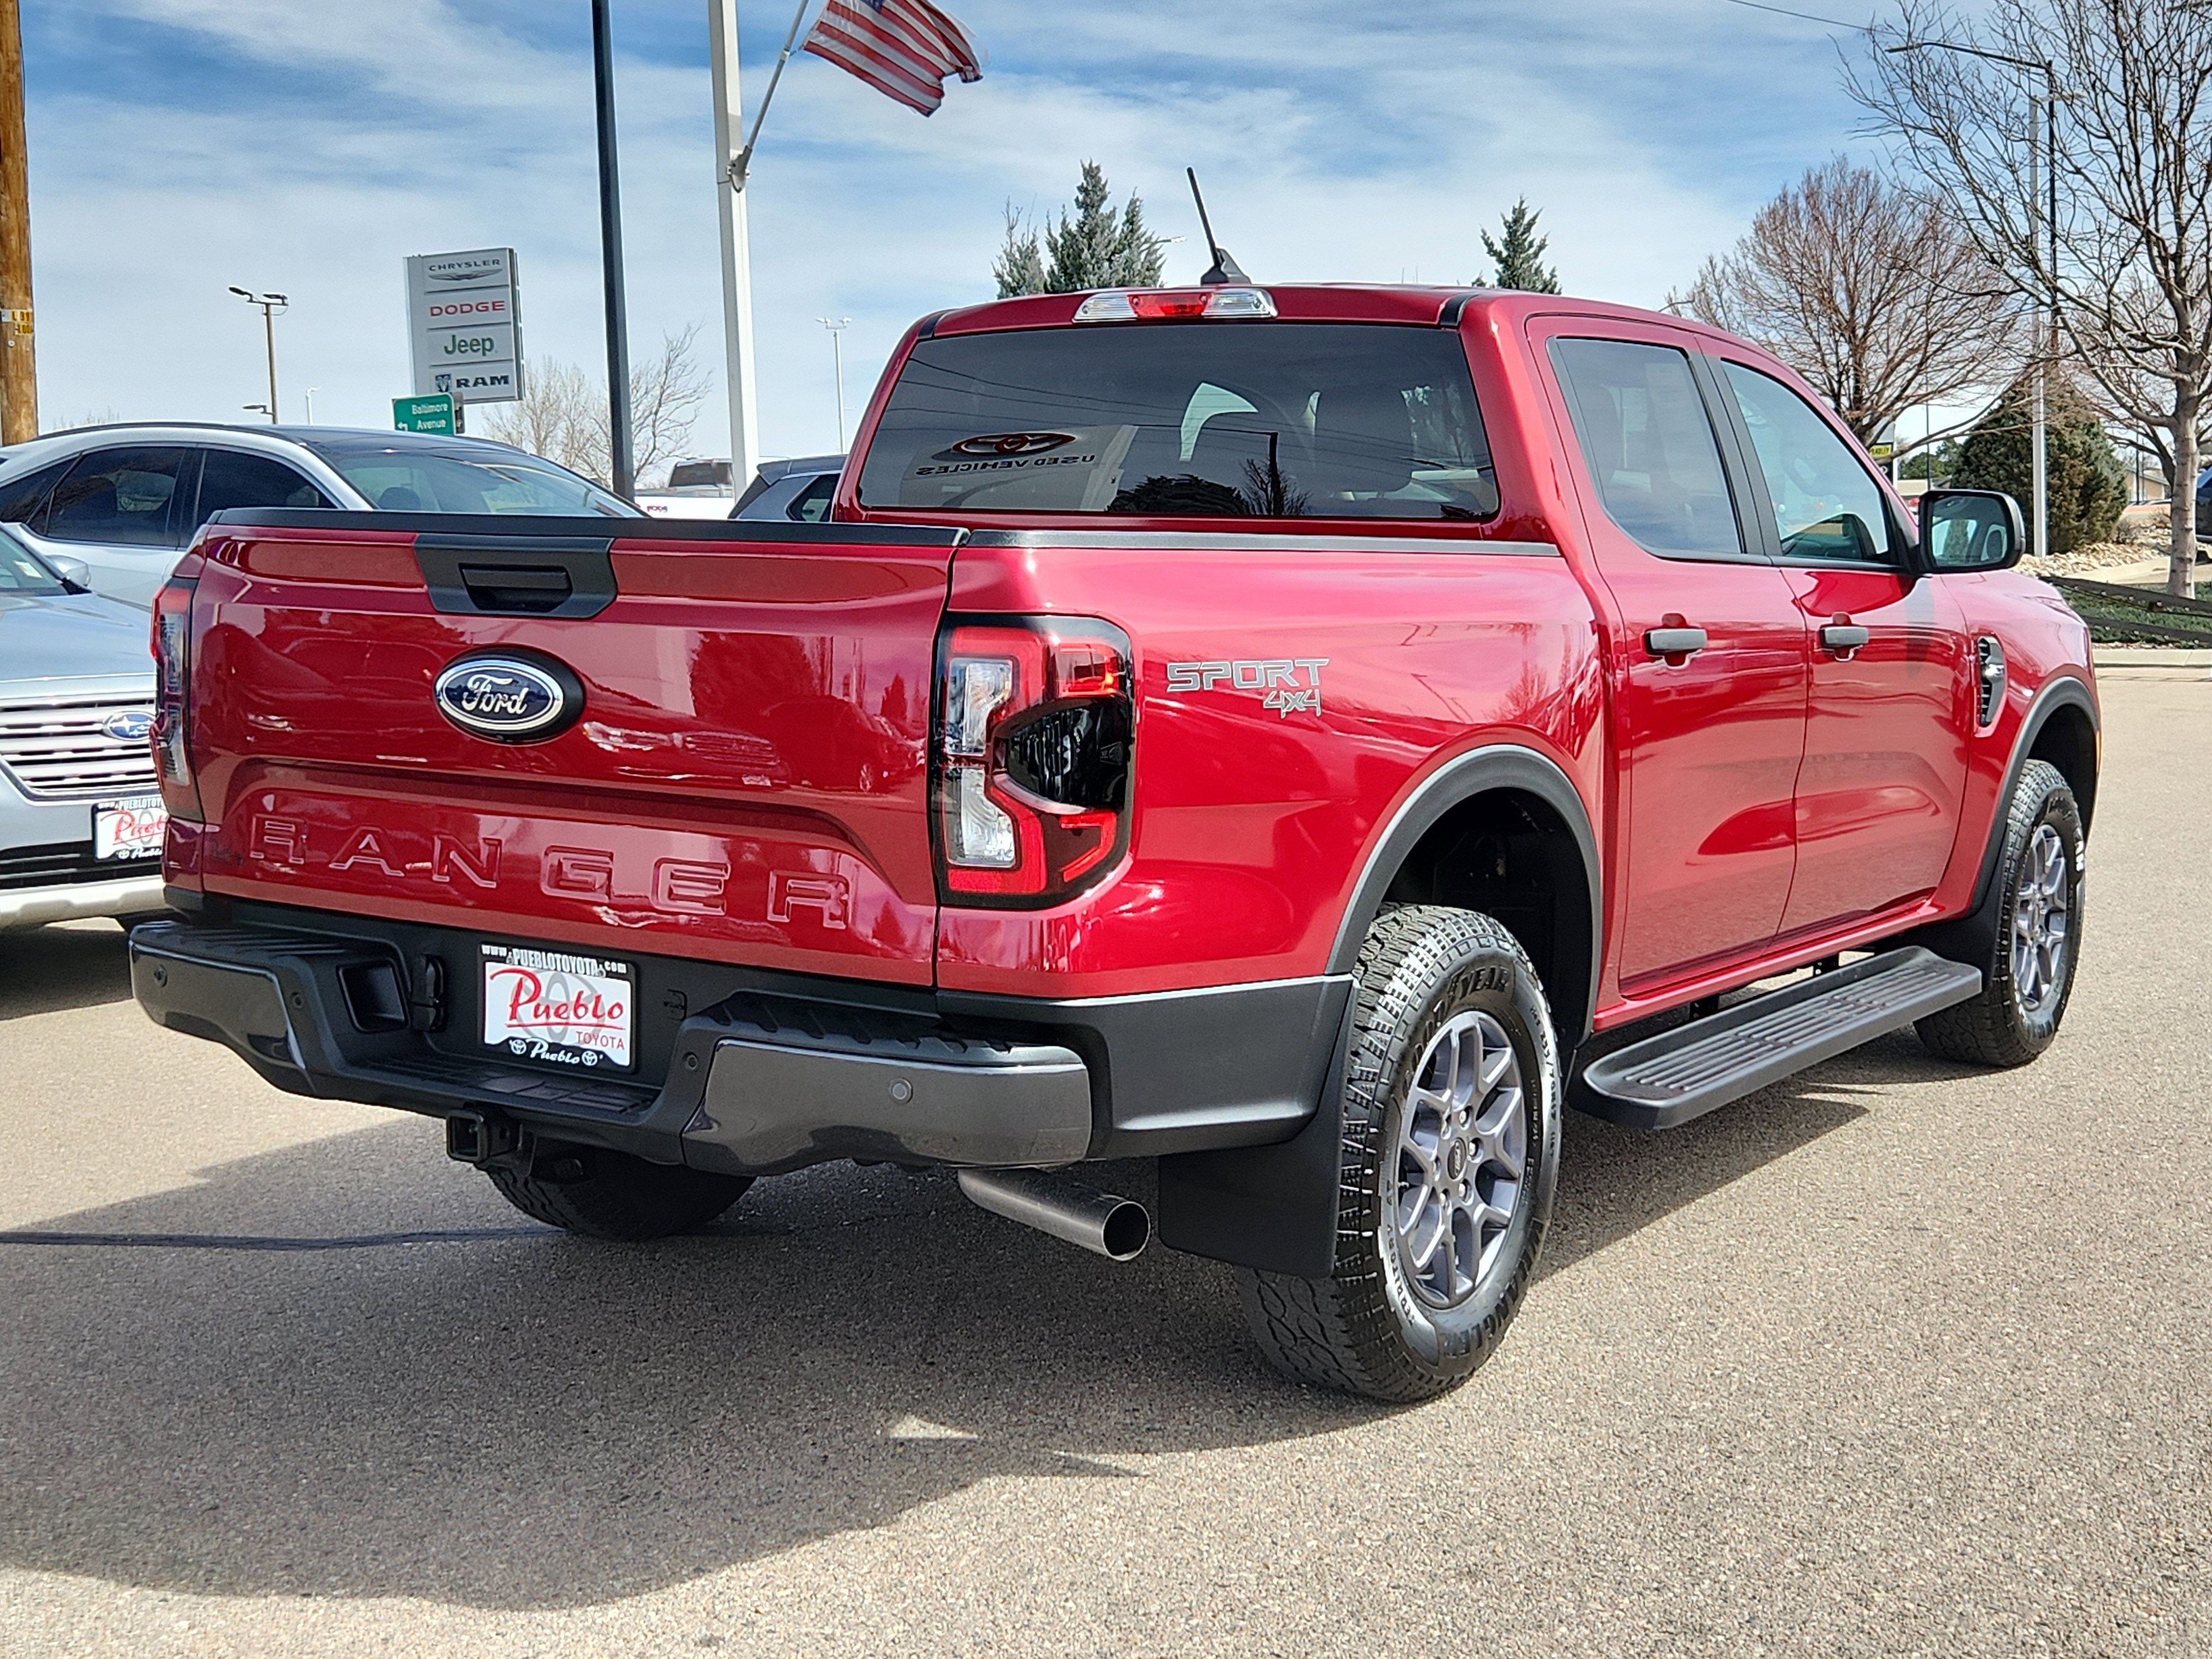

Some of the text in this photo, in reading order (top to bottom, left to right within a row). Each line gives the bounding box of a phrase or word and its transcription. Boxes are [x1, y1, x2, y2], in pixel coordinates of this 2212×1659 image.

[429, 259, 500, 271] CHRYSLER
[429, 300, 506, 317] DODGE
[443, 334, 494, 356] Jeep
[456, 375, 510, 388] RAM
[412, 403, 448, 415] Baltimore
[416, 419, 446, 430] Avenue
[1166, 658, 1330, 692] SPORT
[461, 673, 529, 715] Ford
[249, 813, 851, 930] RANGER
[490, 968, 624, 1021] Pueblo
[576, 1031, 625, 1050] TOYOTA
[525, 1038, 581, 1065] Pueblo
